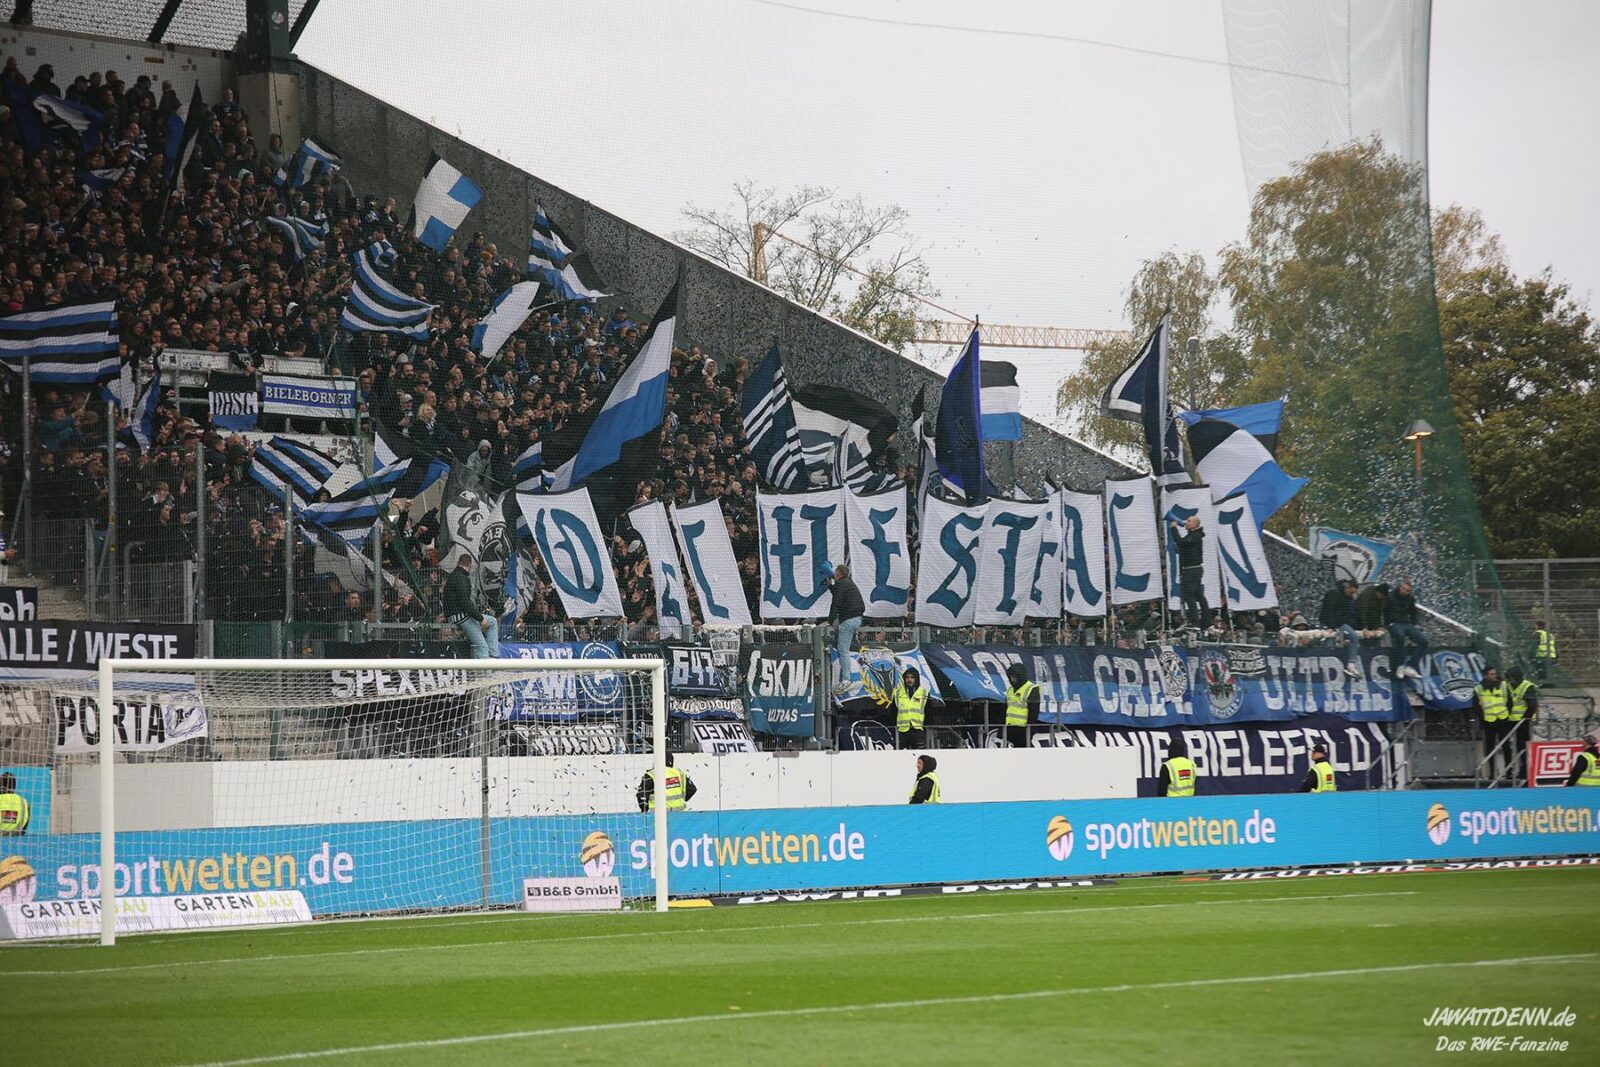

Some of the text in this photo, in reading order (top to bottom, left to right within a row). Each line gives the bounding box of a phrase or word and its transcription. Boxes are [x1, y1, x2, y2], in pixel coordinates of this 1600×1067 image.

[55, 695, 166, 746] PORTA
[1085, 809, 1276, 860] sportwetten.de
[543, 886, 572, 896] B&B
[574, 885, 619, 896] GmbH
[21, 898, 148, 919] GARTENAU
[174, 893, 294, 912] GARTENBAU
